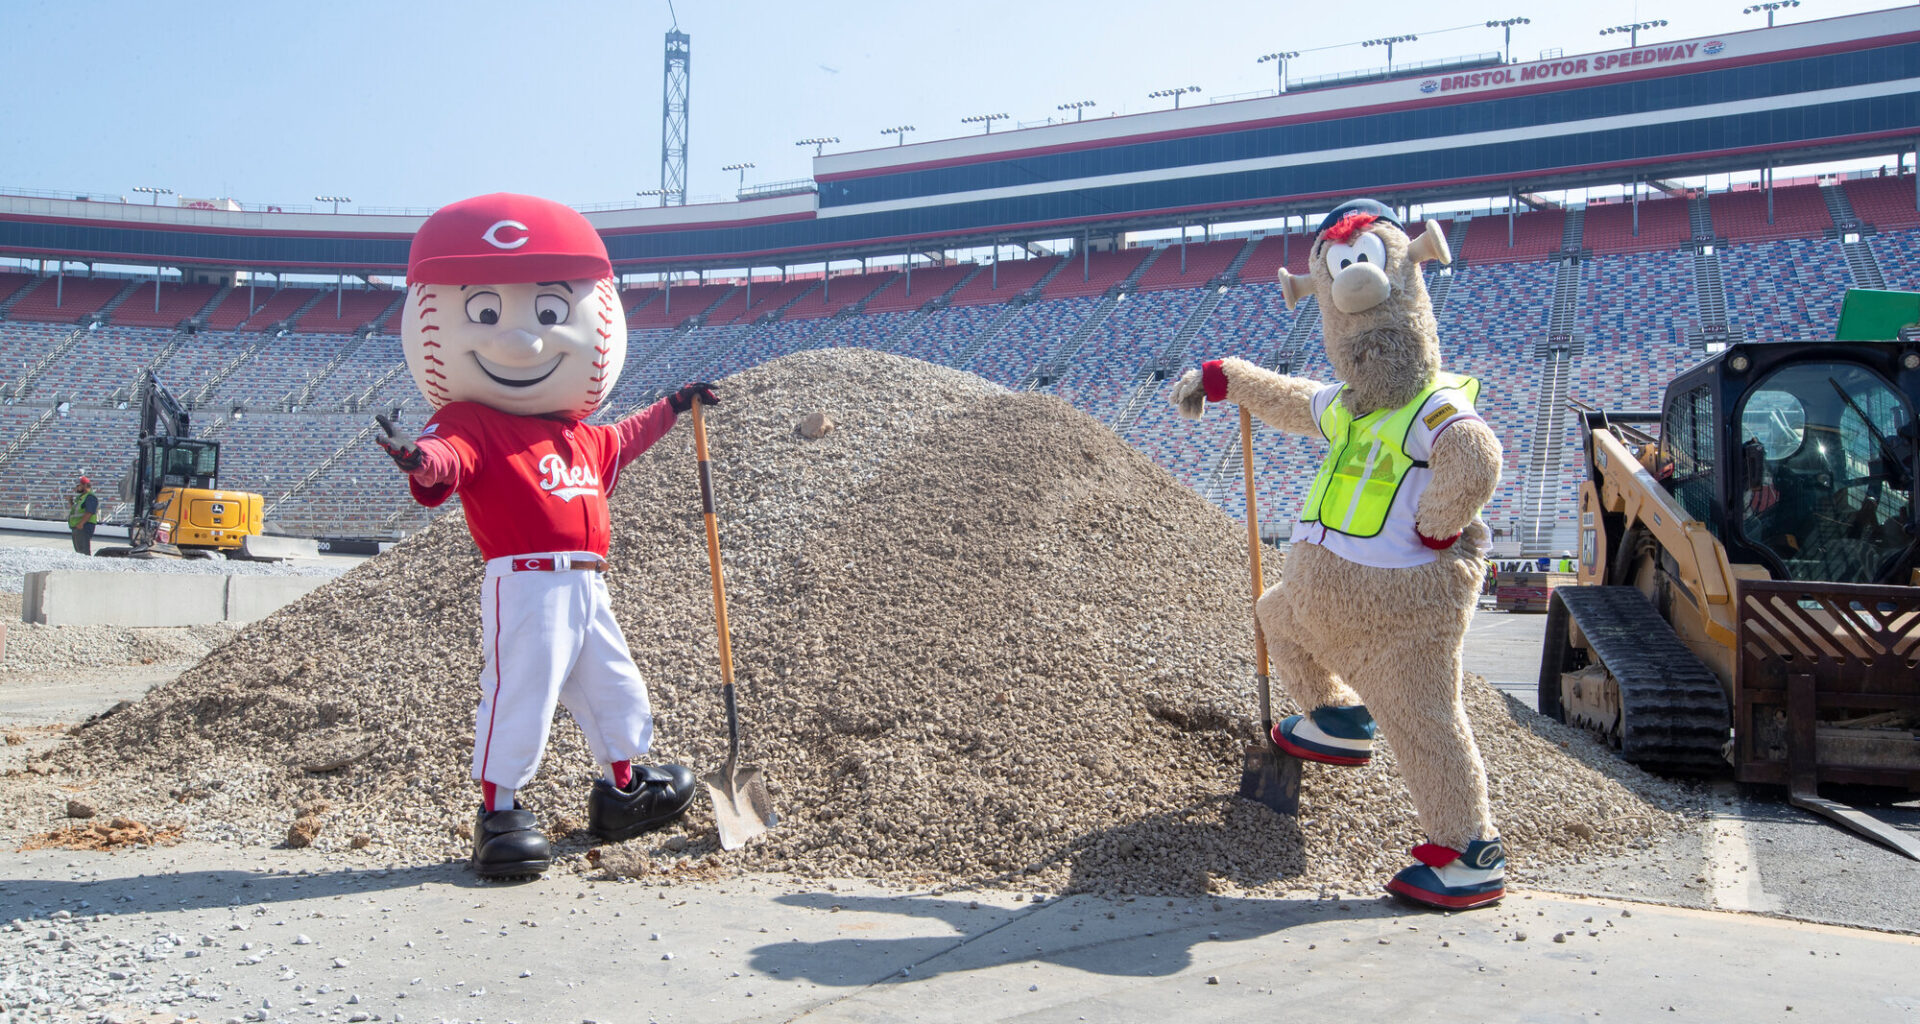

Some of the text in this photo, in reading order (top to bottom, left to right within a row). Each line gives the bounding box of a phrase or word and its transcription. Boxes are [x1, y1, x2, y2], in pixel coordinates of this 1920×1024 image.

[1440, 69, 1516, 91] BRISTOL
[1520, 59, 1588, 81] MOTOR
[1593, 43, 1699, 71] SPEEDWAY
[481, 219, 529, 249] C
[1582, 529, 1596, 565] CAT
[525, 559, 540, 570] C
